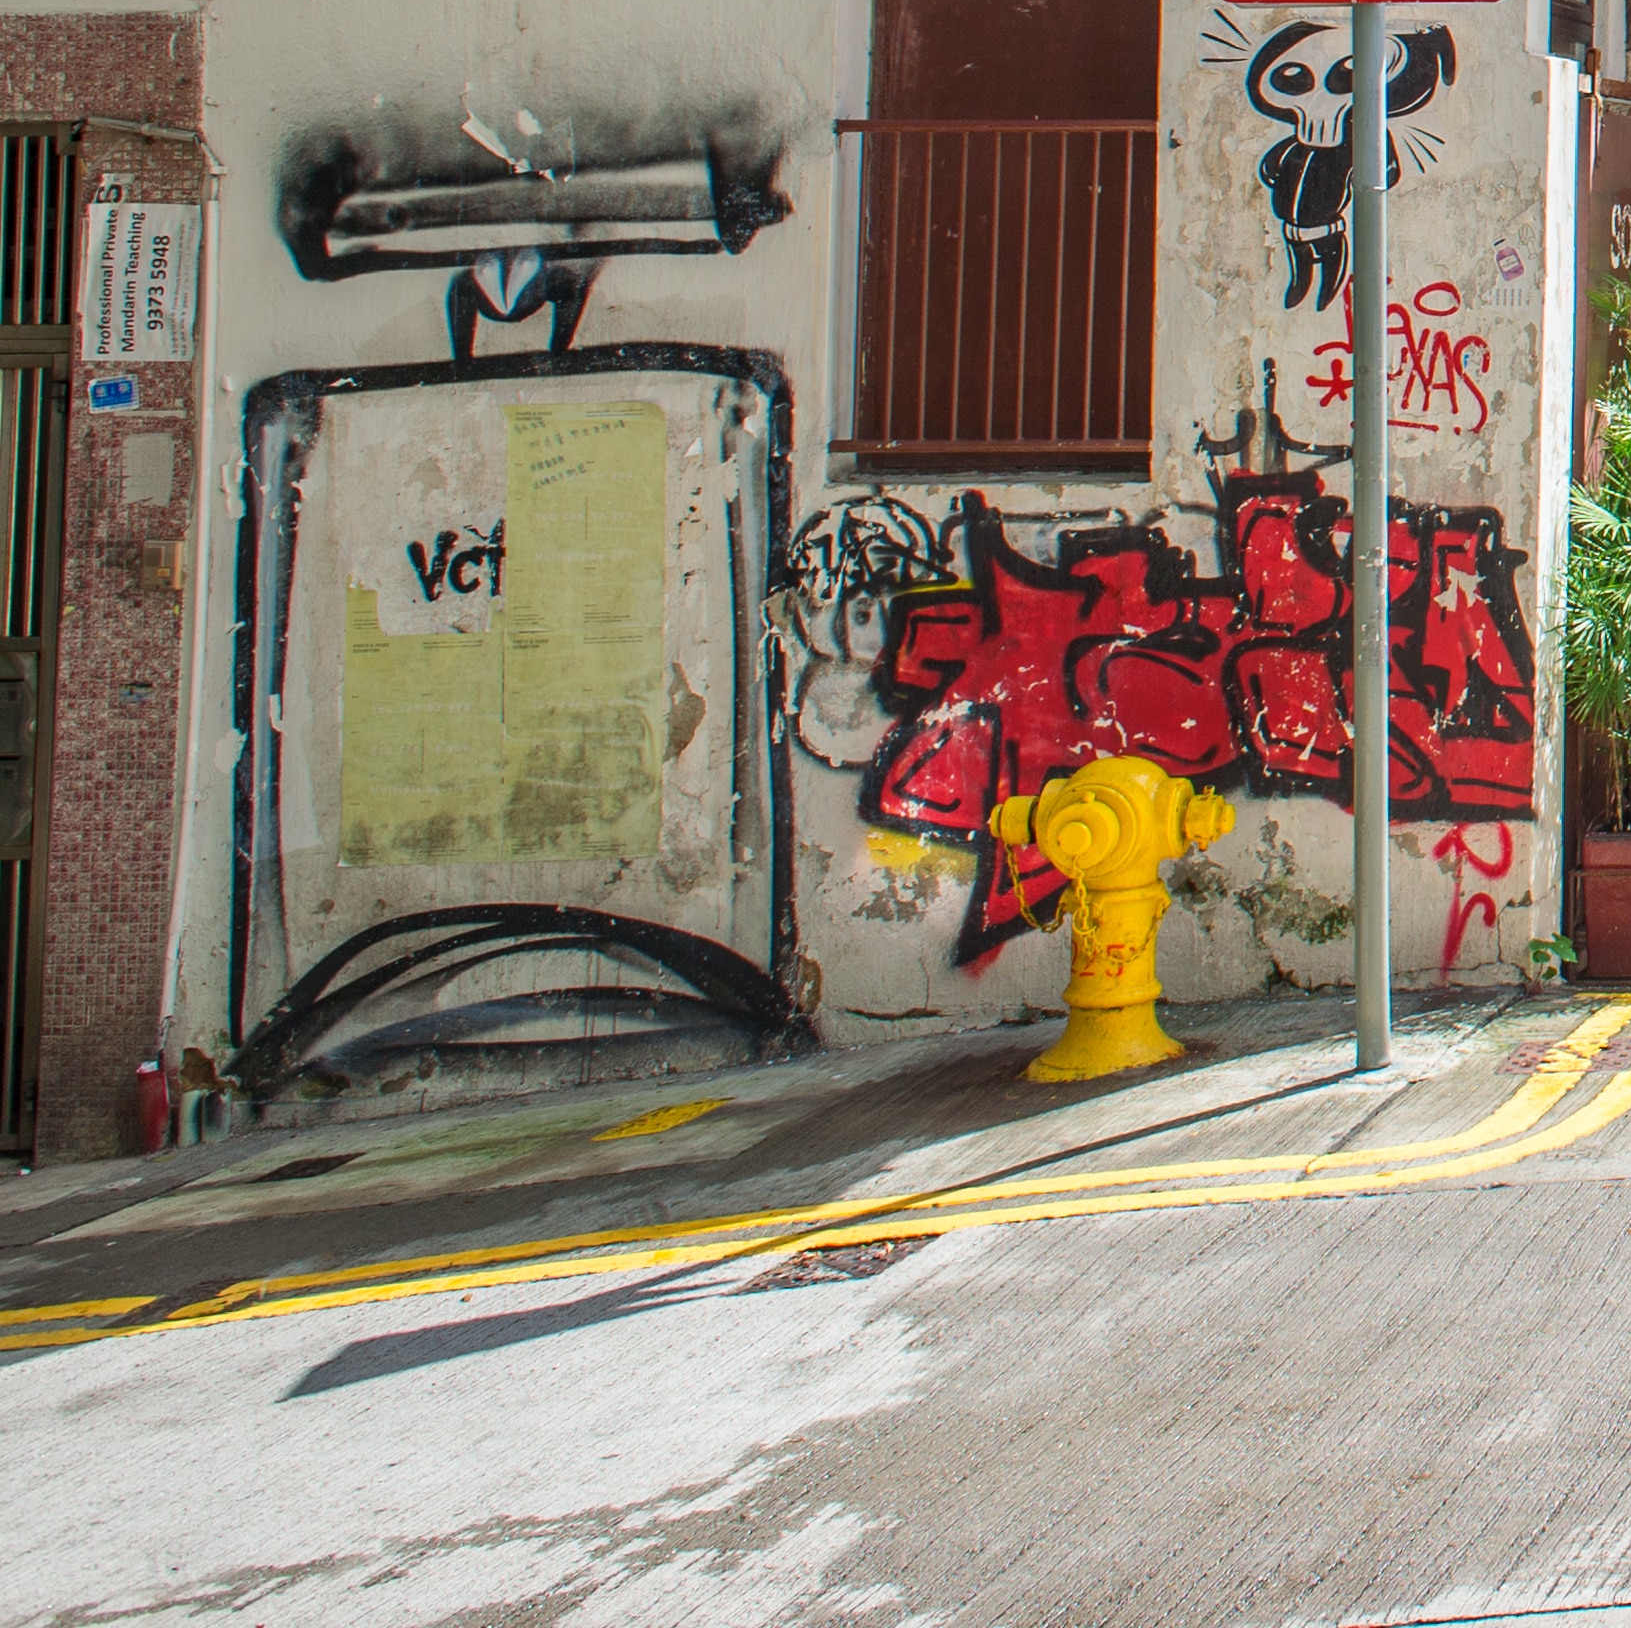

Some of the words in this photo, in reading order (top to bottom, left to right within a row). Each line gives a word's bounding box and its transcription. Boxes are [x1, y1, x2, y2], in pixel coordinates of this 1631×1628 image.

[101, 209, 119, 260] Private
[125, 211, 146, 276] Teaching
[151, 235, 171, 280] 5948
[96, 263, 115, 354] Professional
[121, 280, 138, 353] Mandarin
[147, 285, 165, 332] 9373
